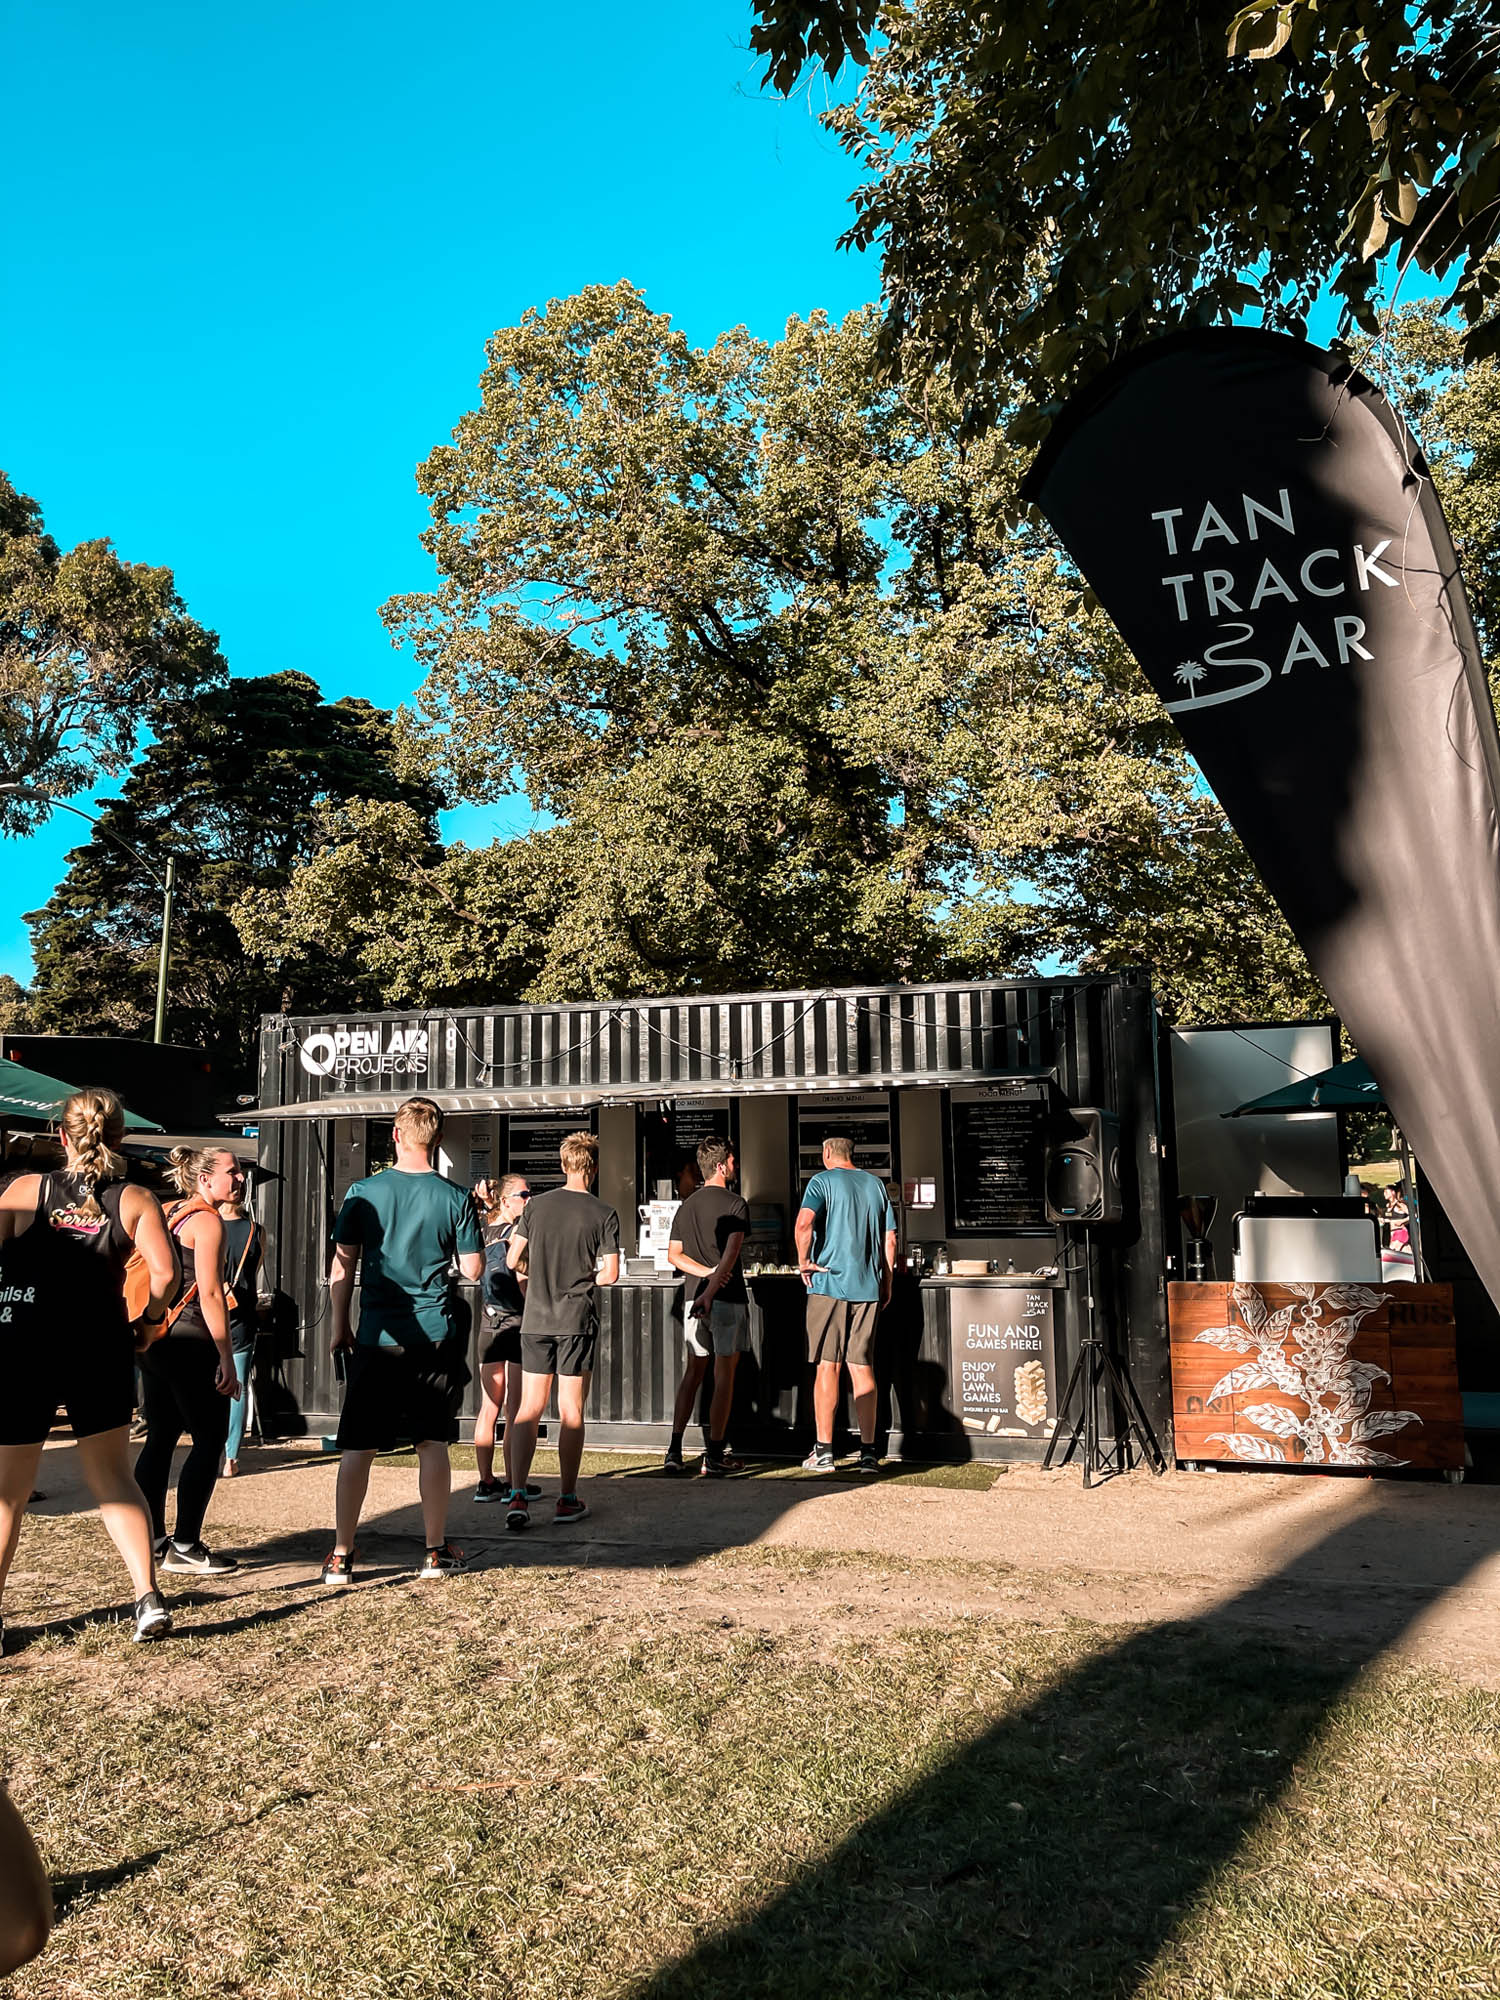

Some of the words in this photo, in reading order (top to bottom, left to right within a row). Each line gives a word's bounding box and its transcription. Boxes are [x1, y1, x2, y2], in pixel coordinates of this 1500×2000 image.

[1151, 488, 1295, 556] TAN
[1161, 538, 1400, 622] TRACK
[300, 1030, 379, 1076] OPEN
[386, 1030, 428, 1054] AIR
[1026, 1301, 1049, 1309] TRACK
[968, 1324, 999, 1338] FUN
[1004, 1325, 1040, 1339] AND
[966, 1339, 1007, 1350] GAMES
[962, 1362, 996, 1372] ENJOY
[962, 1372, 985, 1382] OUR
[962, 1382, 995, 1393] LAWN
[963, 1393, 1001, 1403] GAMES
